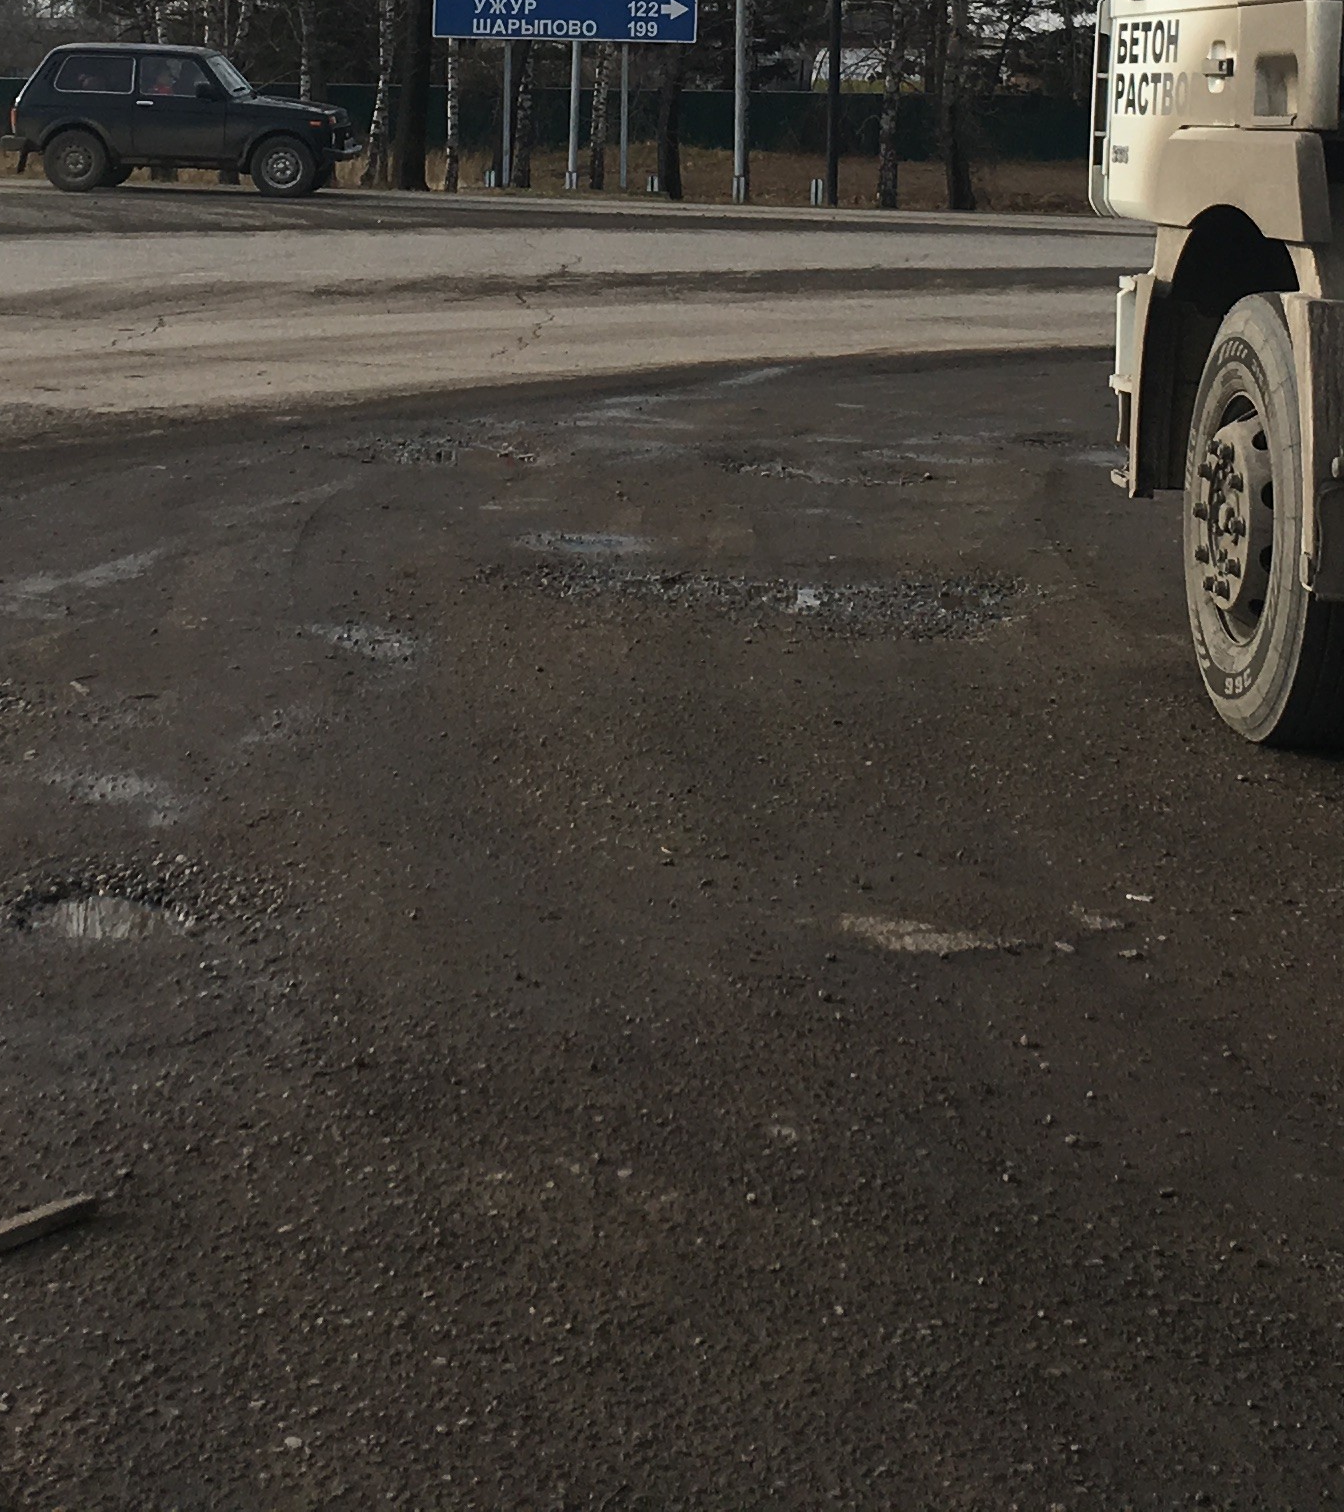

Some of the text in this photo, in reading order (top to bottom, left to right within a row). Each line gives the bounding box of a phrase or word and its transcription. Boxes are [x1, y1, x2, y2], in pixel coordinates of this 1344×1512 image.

[627, 1, 659, 17] 122
[472, 18, 658, 37] ШАРЫПОВО 199
[1117, 19, 1180, 64] БЕТОН
[1114, 71, 1196, 116] РАСТВО
